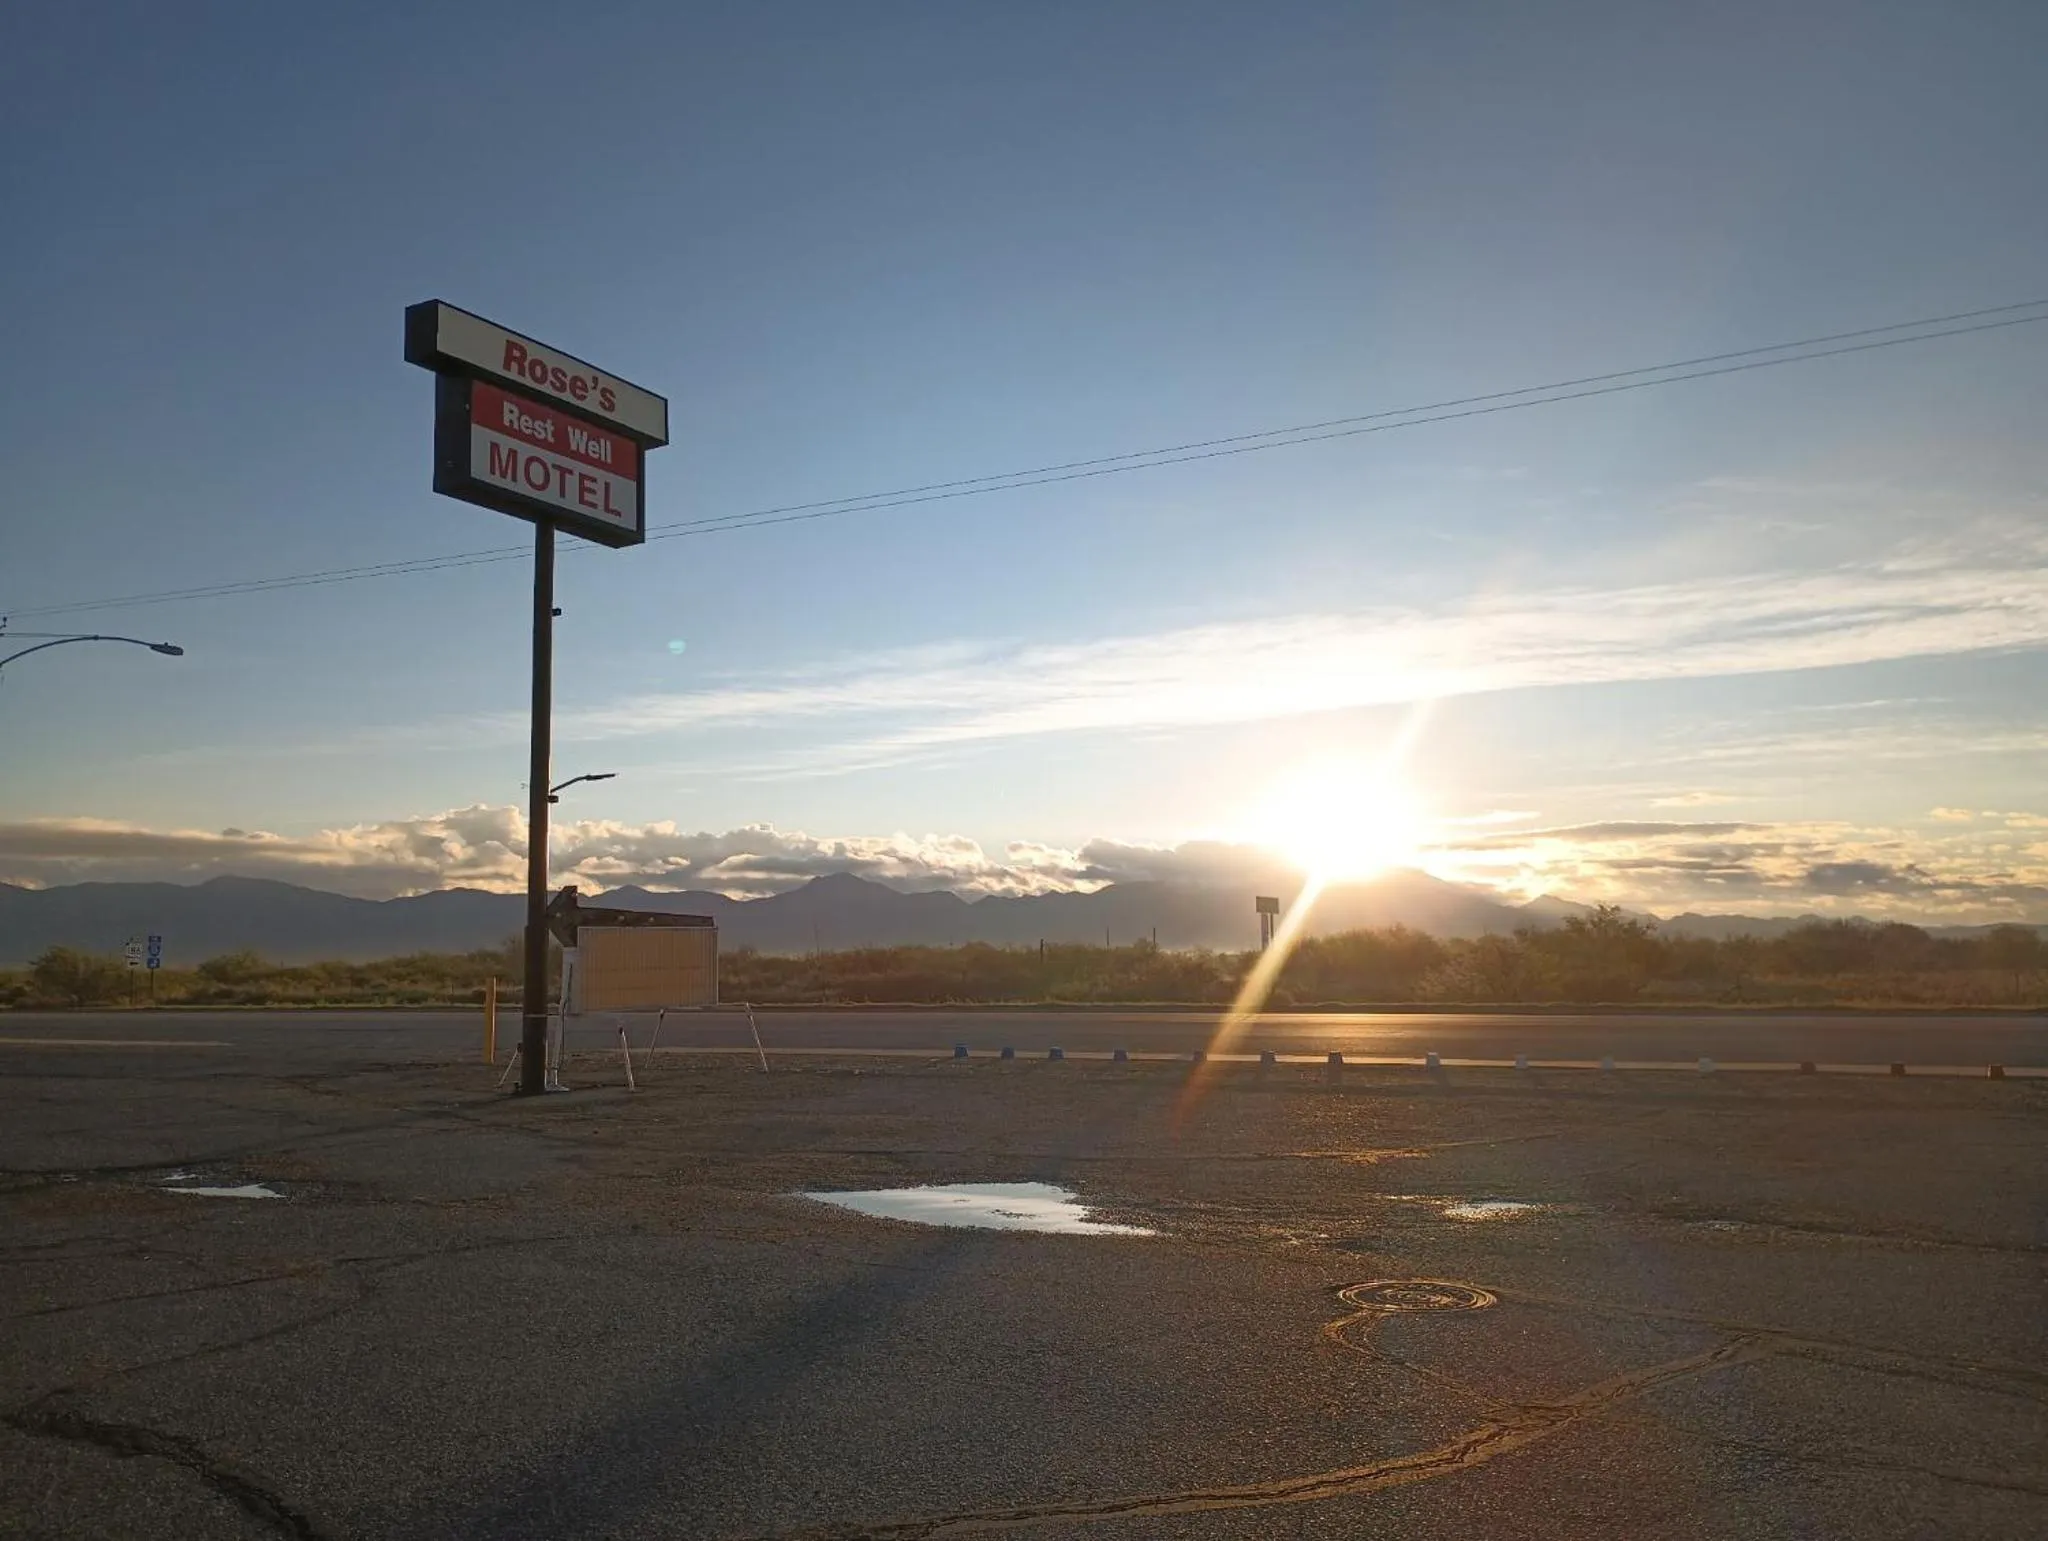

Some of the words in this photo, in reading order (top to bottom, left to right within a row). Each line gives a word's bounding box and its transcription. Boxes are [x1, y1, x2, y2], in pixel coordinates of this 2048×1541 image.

[503, 340, 616, 412] Rose's
[503, 402, 554, 443] Rest
[568, 426, 612, 464] Well
[489, 442, 622, 518] MOTEL
